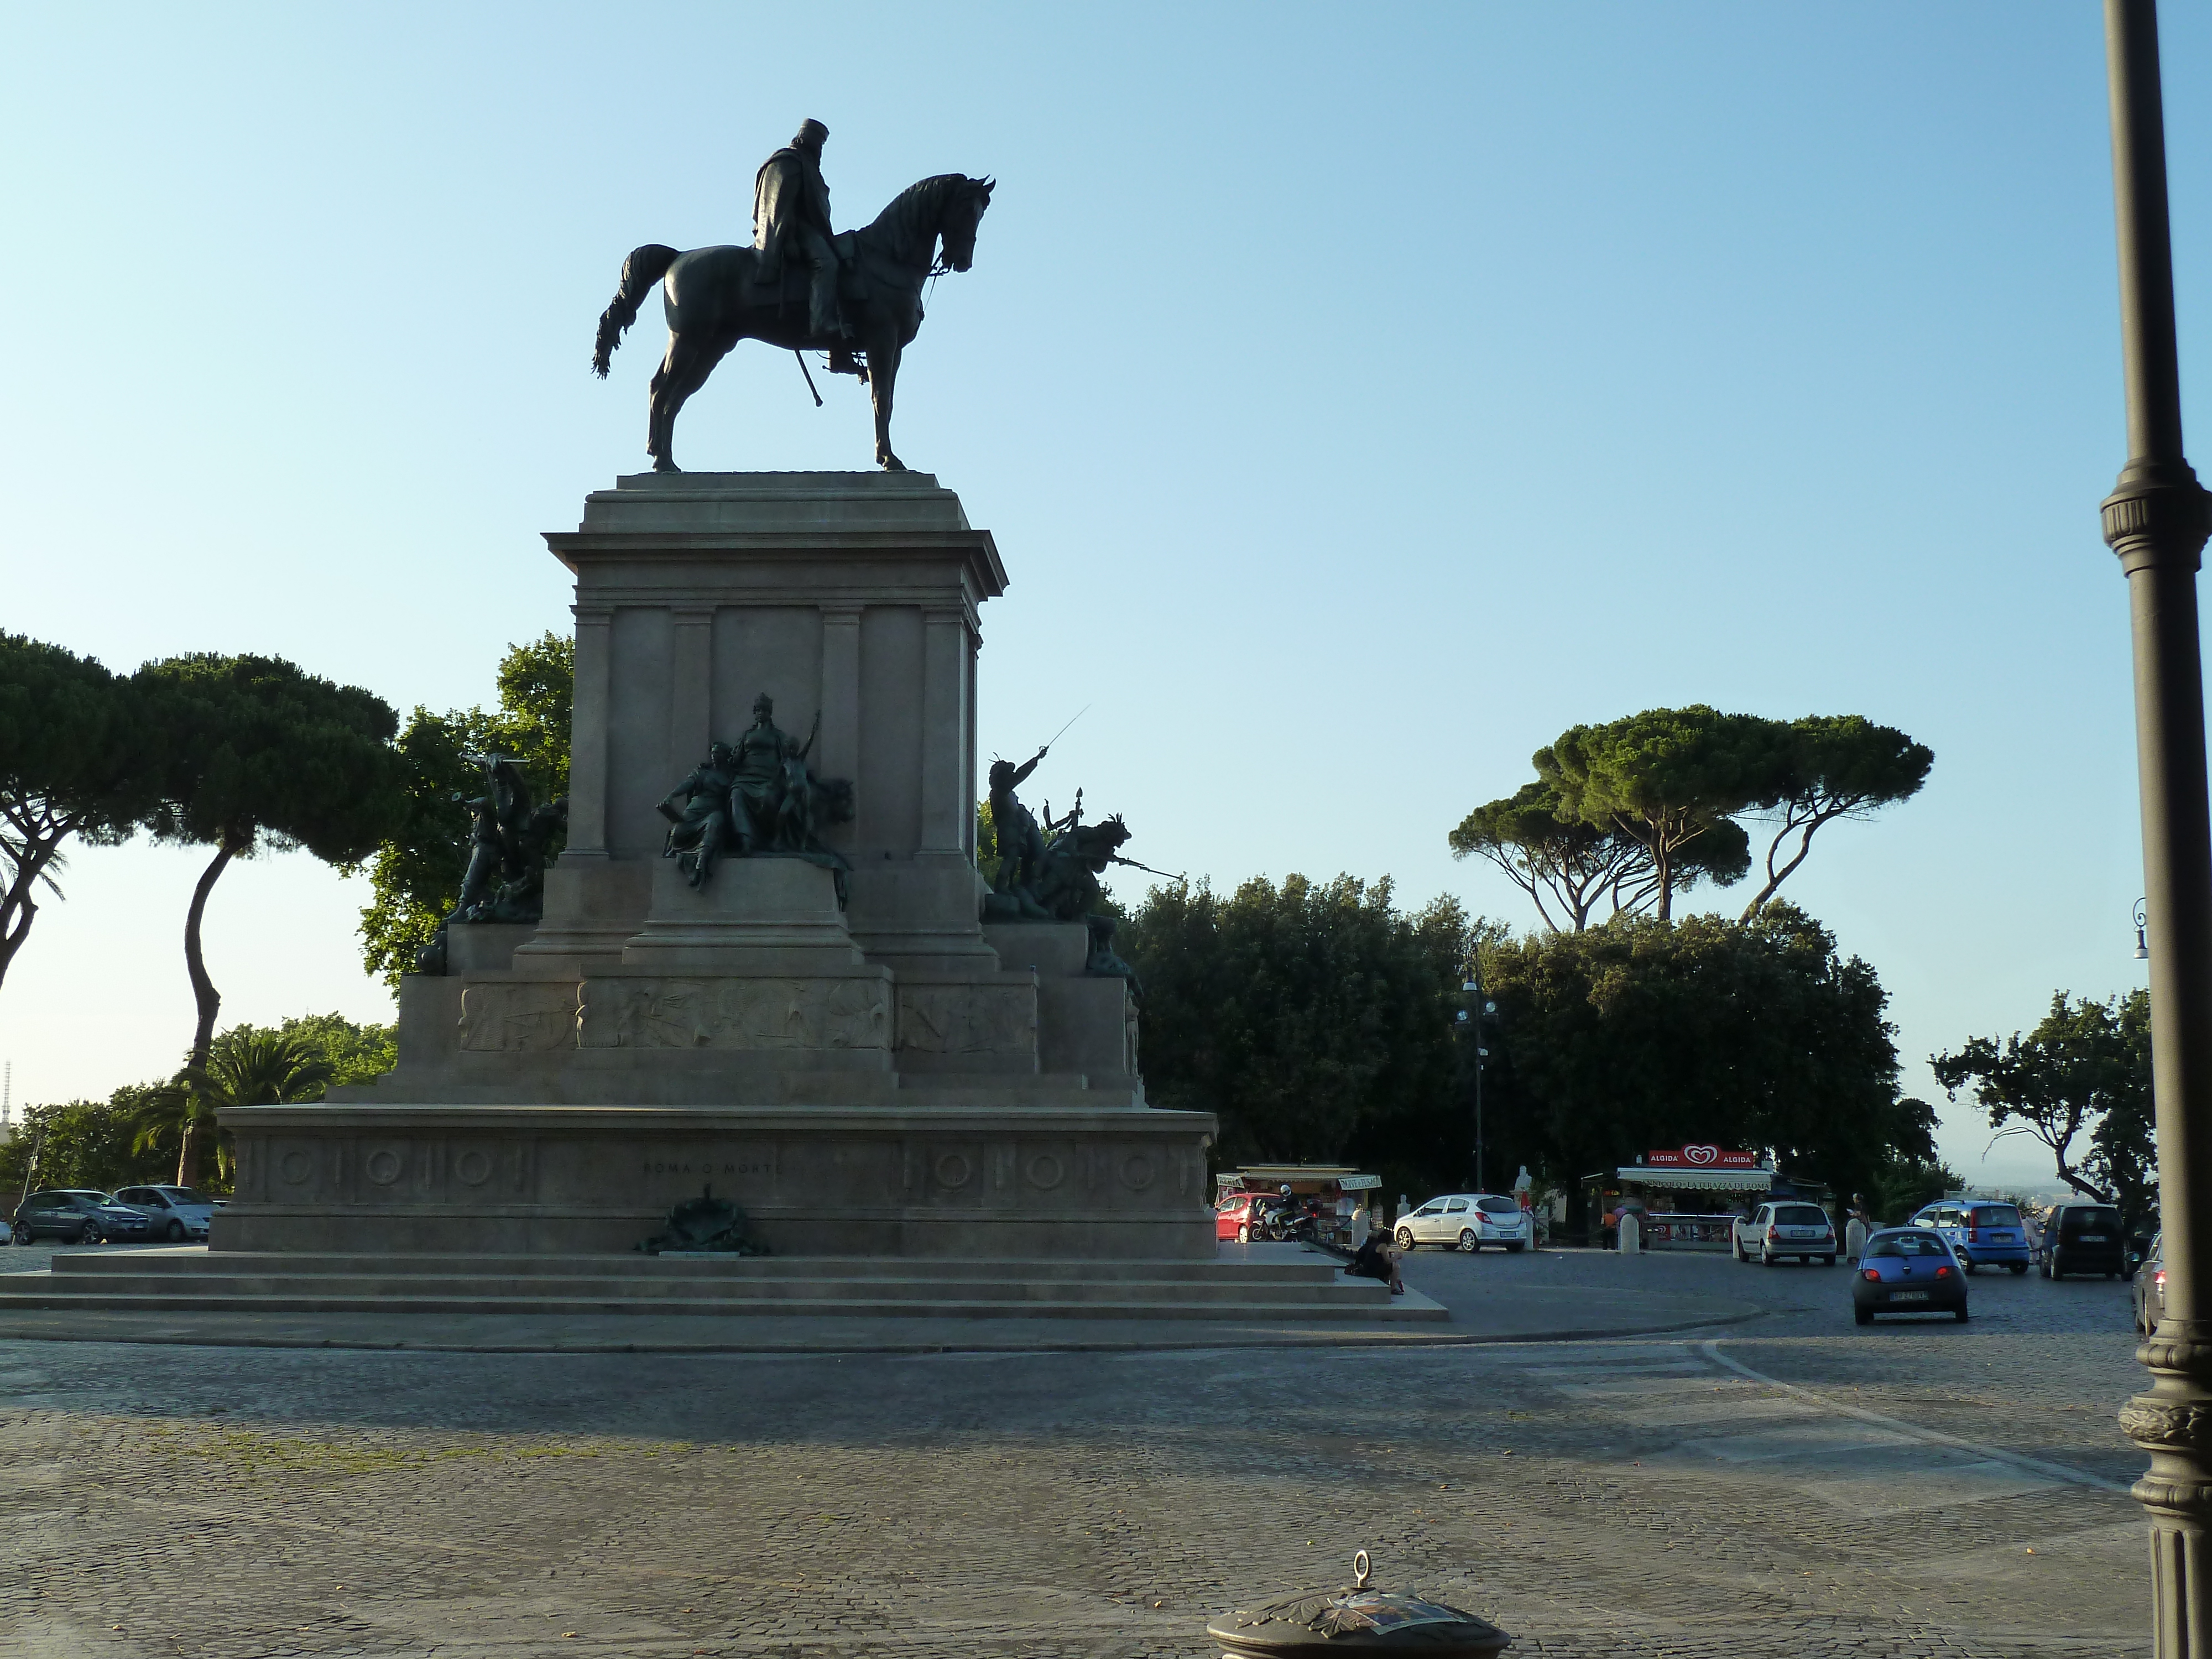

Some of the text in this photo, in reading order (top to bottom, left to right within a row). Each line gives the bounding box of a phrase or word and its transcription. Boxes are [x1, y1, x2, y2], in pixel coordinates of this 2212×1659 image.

[644, 1163, 782, 1175] ROMA O MORTE
